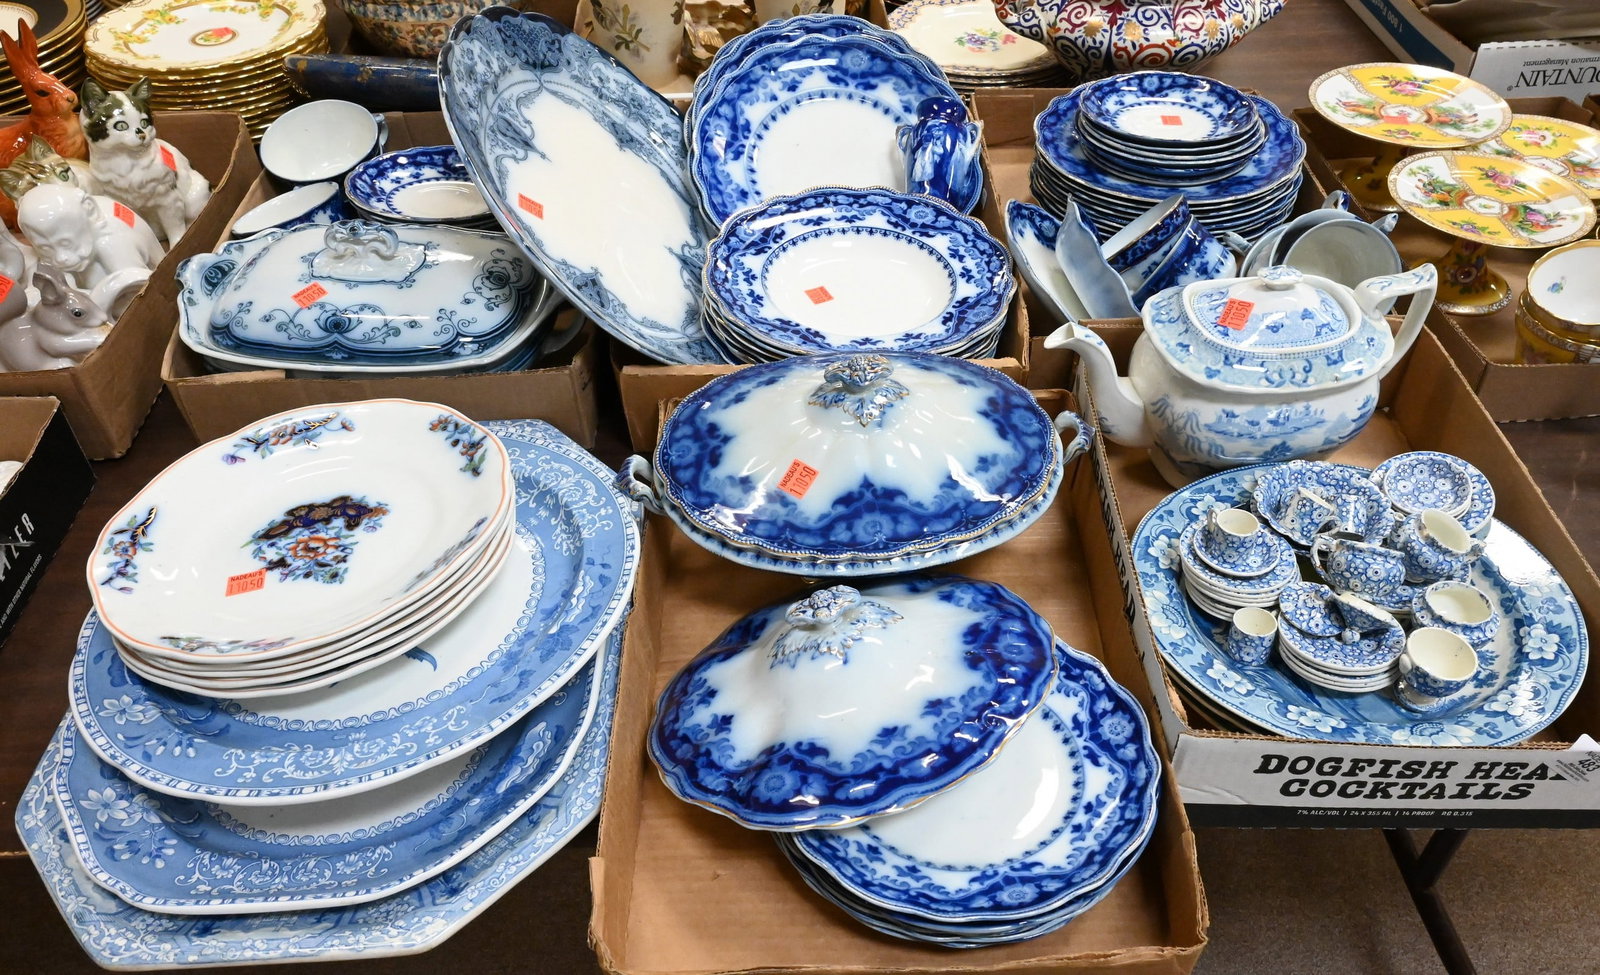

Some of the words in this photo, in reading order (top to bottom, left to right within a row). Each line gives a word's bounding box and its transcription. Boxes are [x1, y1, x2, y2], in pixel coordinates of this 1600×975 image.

[1523, 57, 1570, 67] Management
[780, 461, 800, 487] NADEAU'S
[790, 466, 815, 496] 11050
[229, 577, 264, 594] 11050
[230, 570, 263, 581] NADEAU'S
[1253, 753, 1458, 780] DOGFISH
[1465, 761, 1567, 781] HEA
[1279, 778, 1536, 801] COCKTAILS
